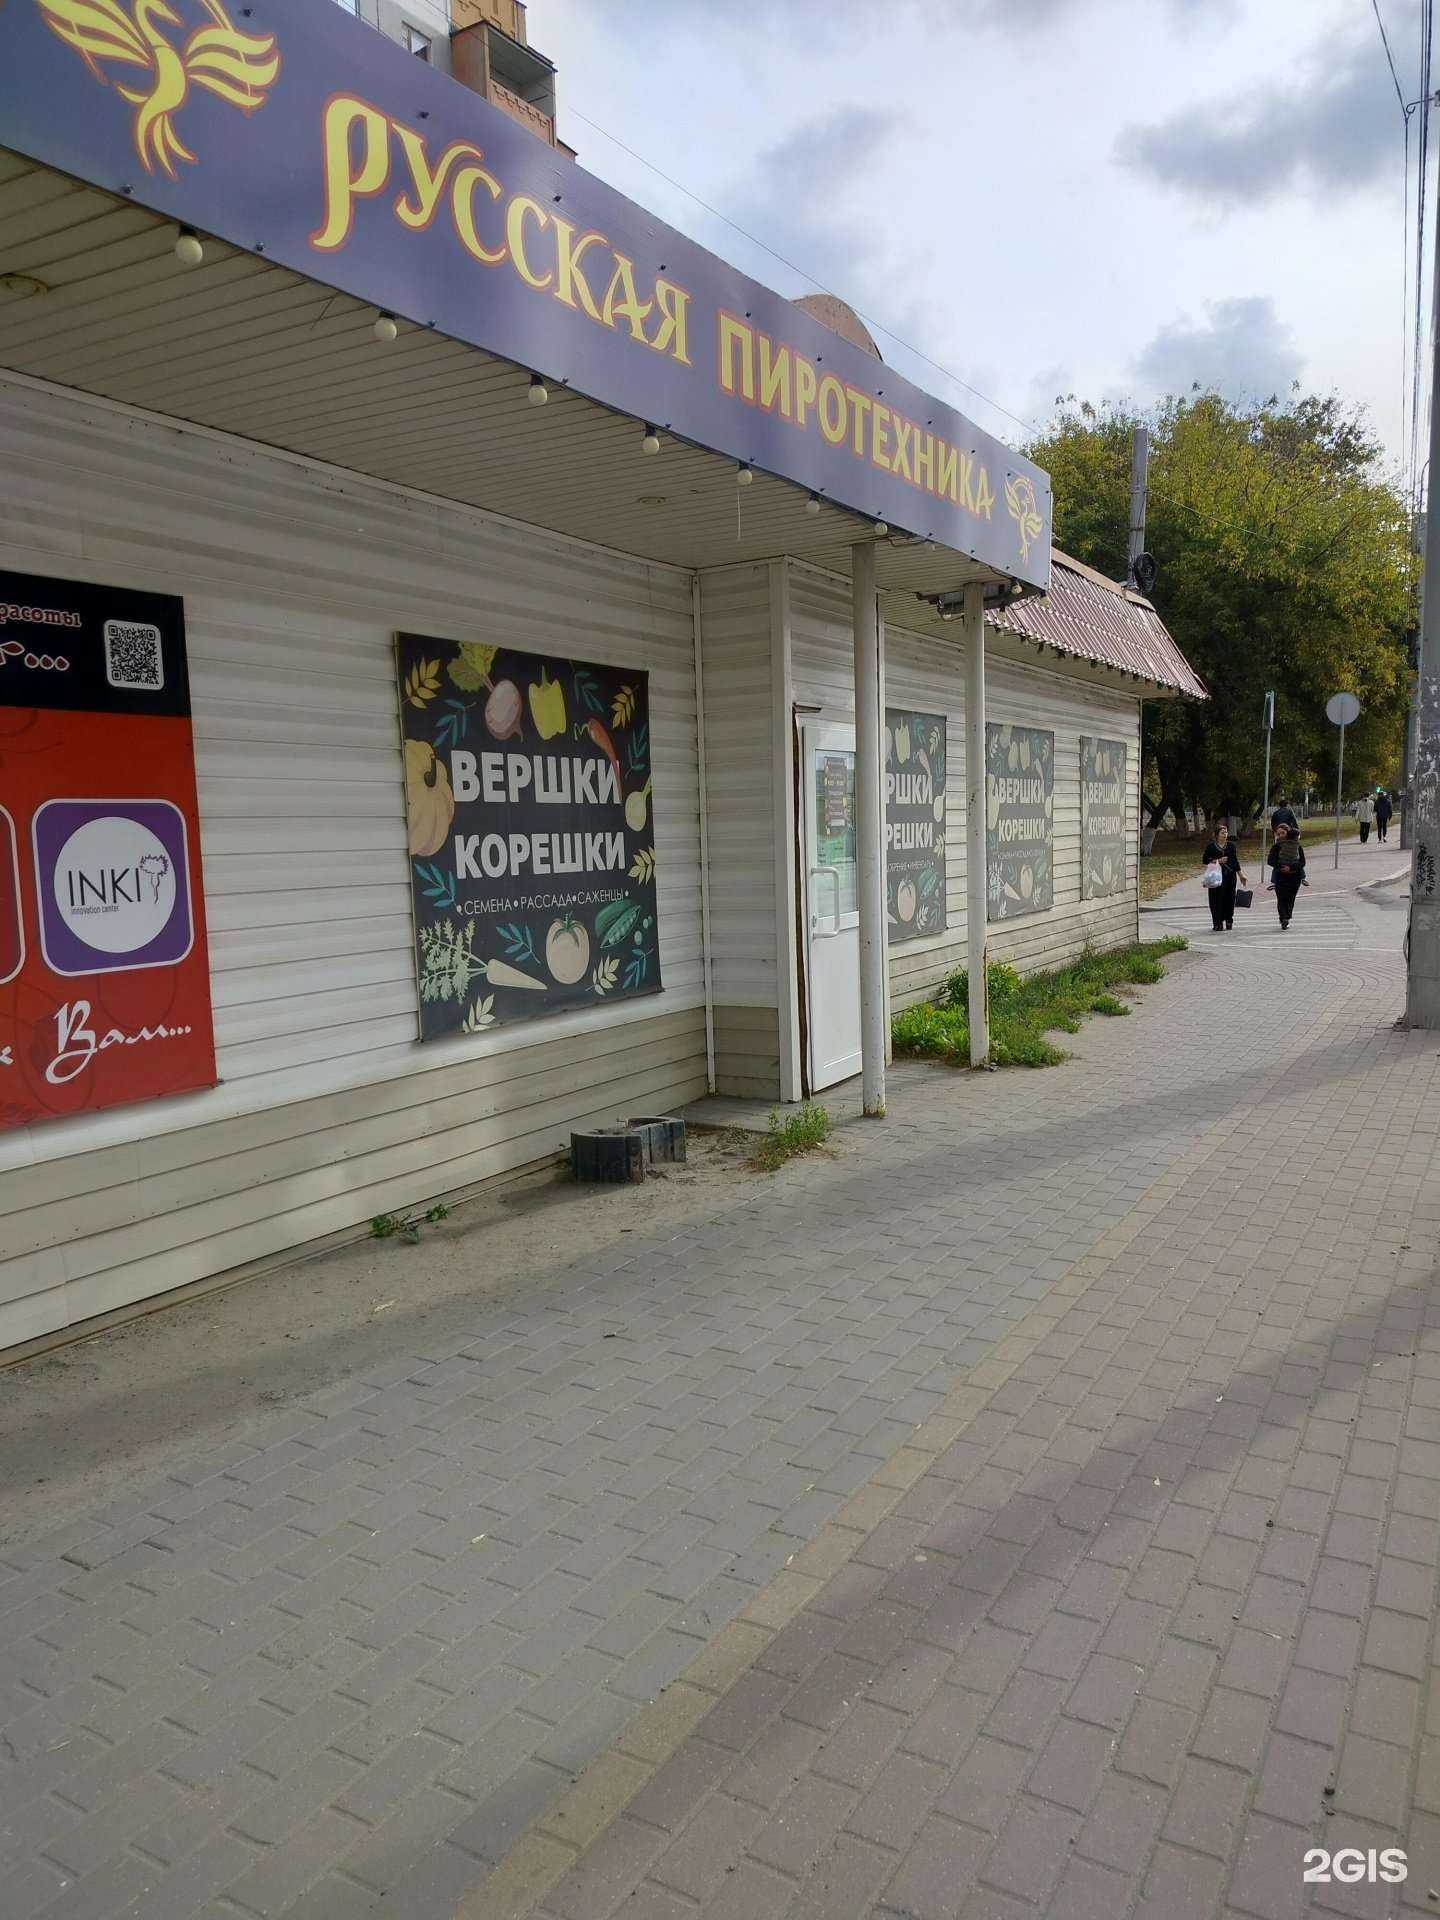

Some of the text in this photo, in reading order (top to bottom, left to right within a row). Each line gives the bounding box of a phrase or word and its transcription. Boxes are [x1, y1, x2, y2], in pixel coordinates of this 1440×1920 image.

[311, 93, 997, 522] РУССКАЯ ПИРОТЕХНИКА
[450, 750, 623, 805] ВЕРШКИ
[999, 777, 1045, 804] ВЕРШКИ
[1088, 782, 1120, 804] ВЕРШКИ
[999, 818, 1045, 842] КОРЕШКИ
[454, 831, 626, 879] КОРЕШКИ
[68, 868, 141, 906] INKI
[464, 889, 624, 915] СЕМЕНА РАССАДА САЖЕНЦЫ
